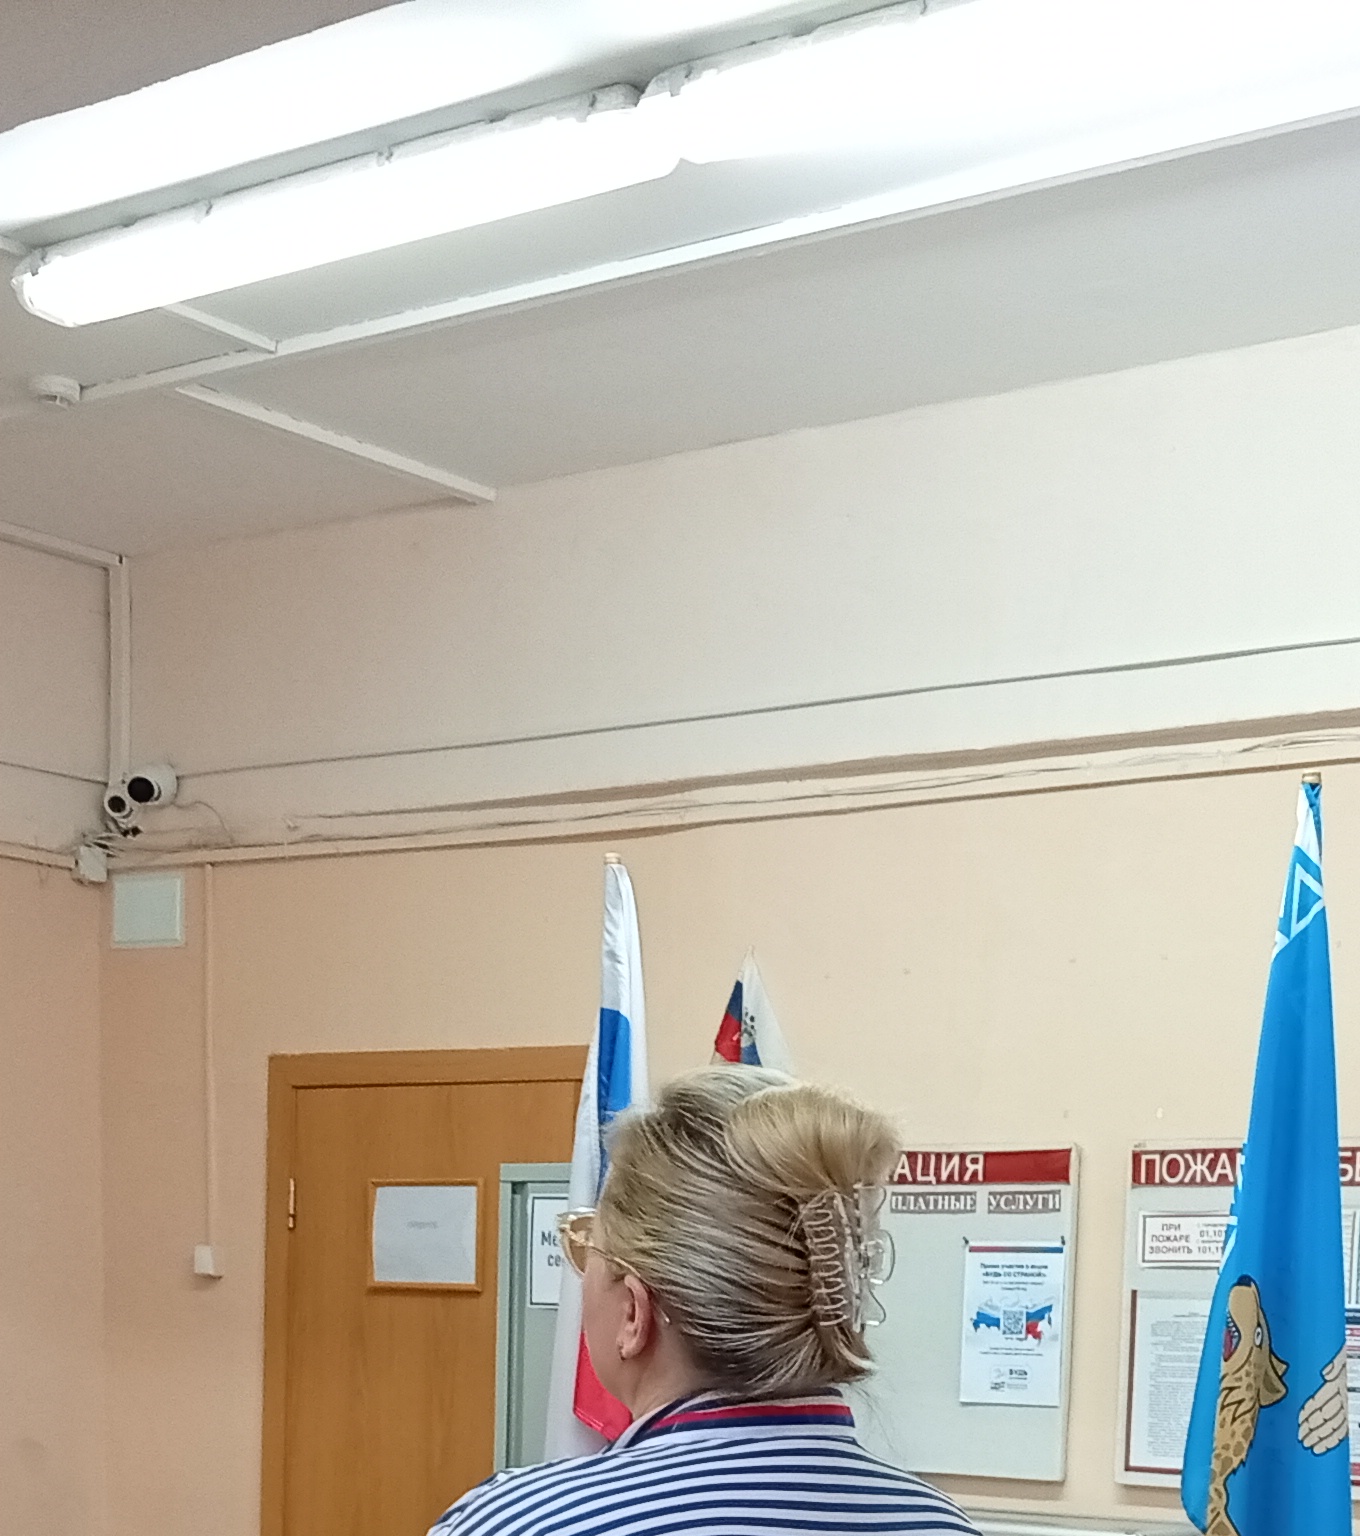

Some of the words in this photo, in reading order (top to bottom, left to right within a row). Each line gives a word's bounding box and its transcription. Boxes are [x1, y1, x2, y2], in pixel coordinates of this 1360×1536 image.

[891, 1153, 984, 1185] АЦИЯ
[892, 1193, 976, 1210] ПЛАТНЫЕ
[989, 1193, 1061, 1209] УСЛУГИ
[1162, 1223, 1181, 1231] ПРИ
[1151, 1234, 1191, 1243] ПОЖАРЕ
[1148, 1246, 1193, 1255] ЗВОНИТЬ
